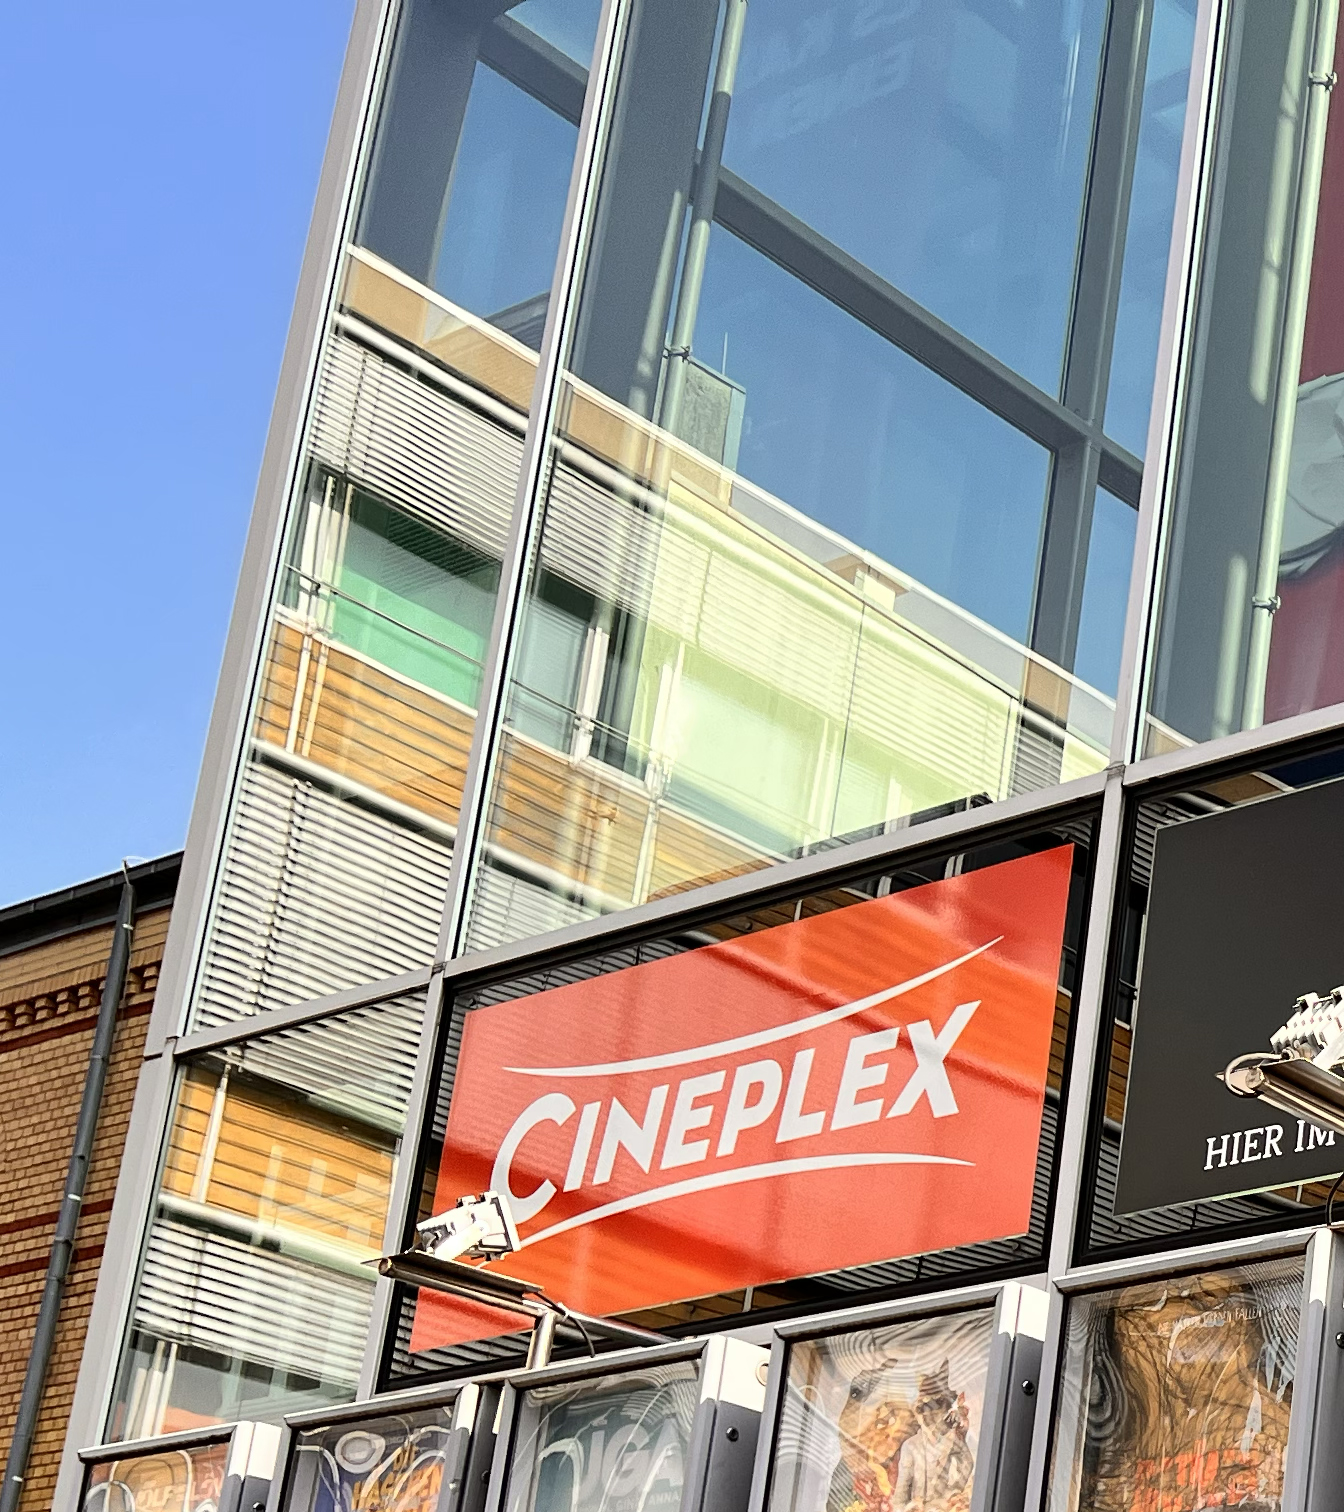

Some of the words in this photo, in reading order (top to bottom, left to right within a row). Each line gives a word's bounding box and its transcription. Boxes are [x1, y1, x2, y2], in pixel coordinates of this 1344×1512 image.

[491, 999, 982, 1226] CINEPLEX
[1203, 1118, 1283, 1171] HIER
[1295, 1115, 1335, 1151] IM
